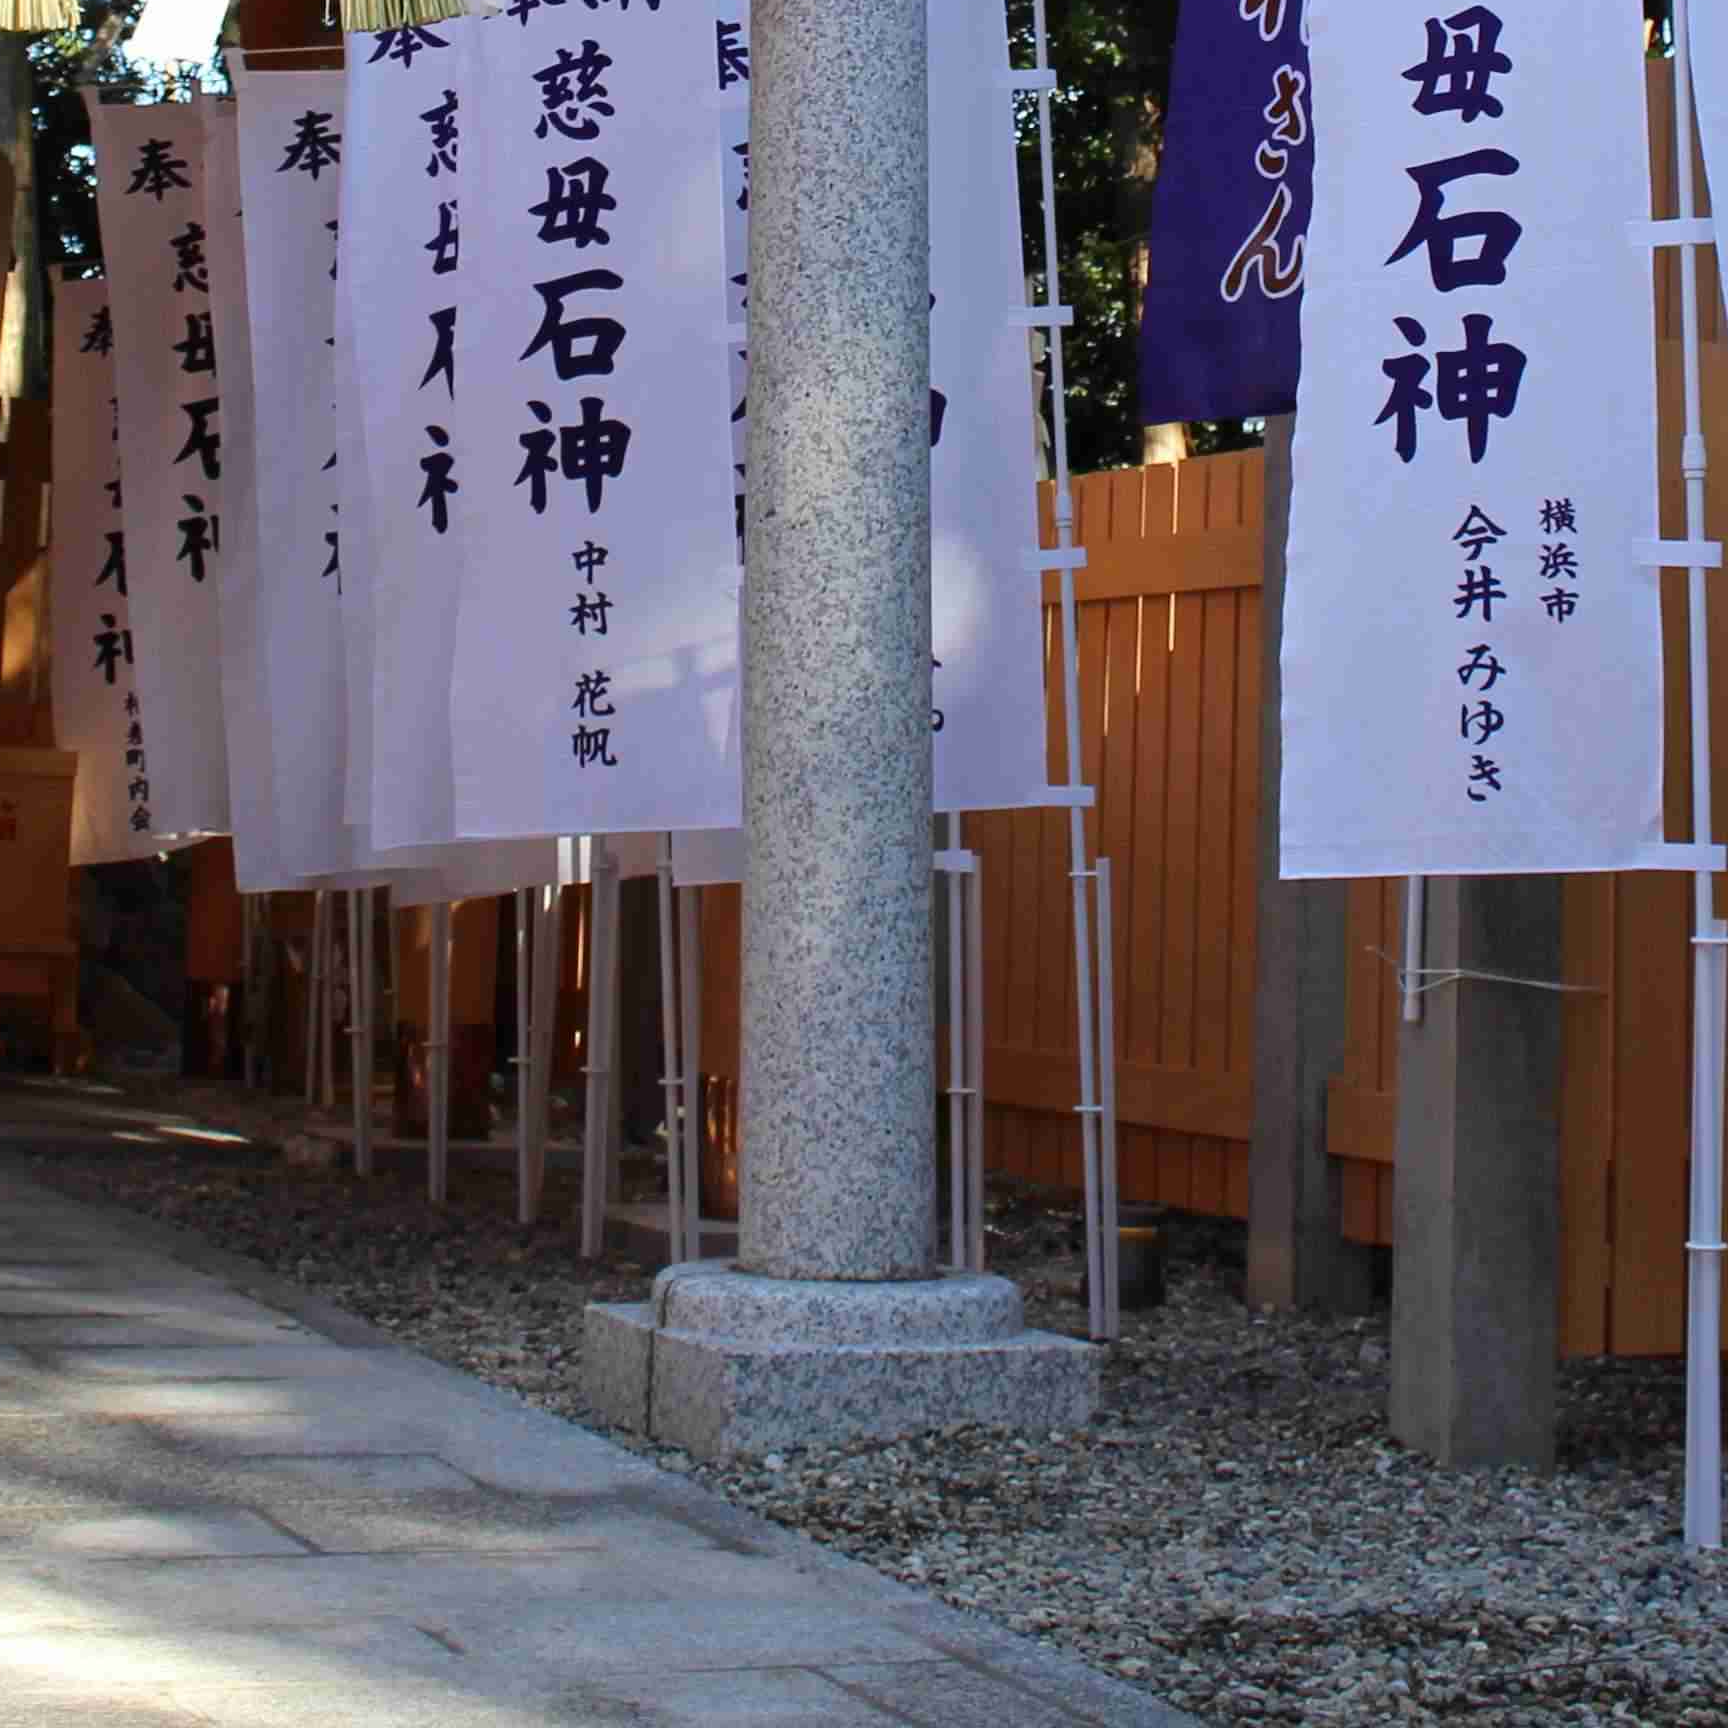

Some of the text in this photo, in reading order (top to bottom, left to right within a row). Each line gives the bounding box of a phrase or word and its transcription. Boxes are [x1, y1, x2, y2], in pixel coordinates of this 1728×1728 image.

[513, 39, 632, 515] 慈母石神
[569, 540, 618, 769] 中村 花帆
[1452, 504, 1507, 802] 今井 みゆき
[1539, 498, 1579, 624] 横浜市
